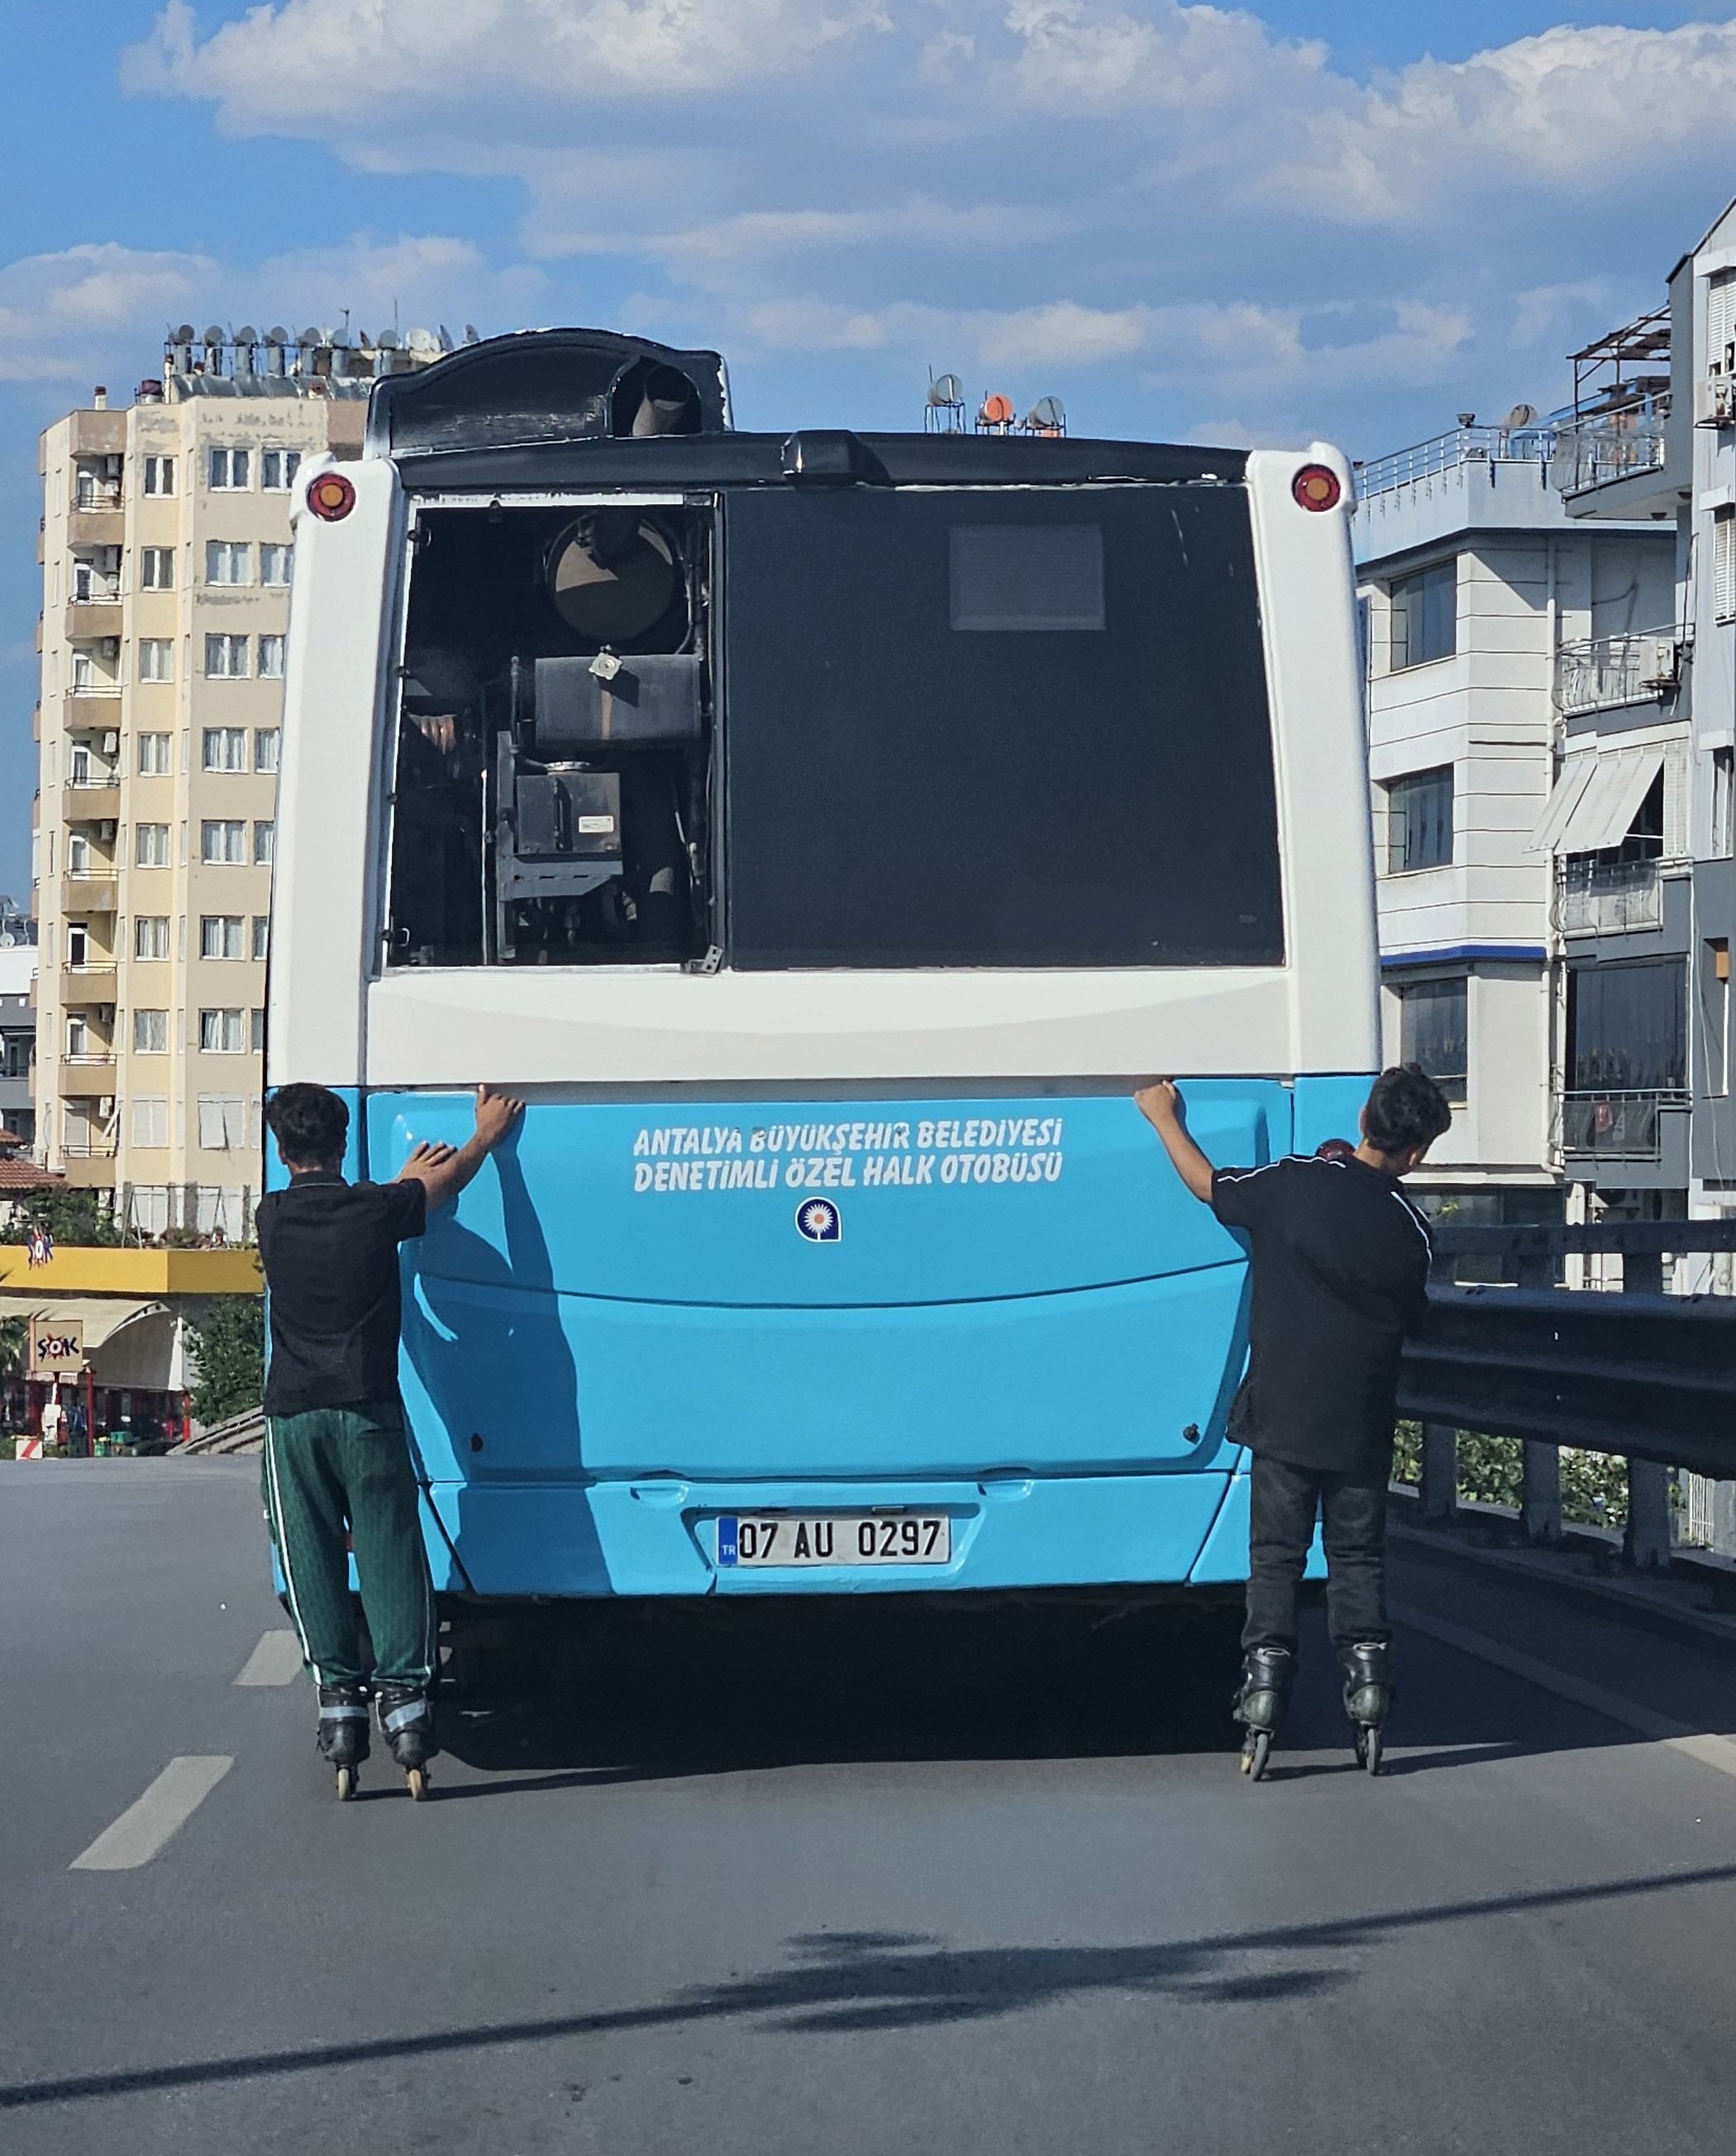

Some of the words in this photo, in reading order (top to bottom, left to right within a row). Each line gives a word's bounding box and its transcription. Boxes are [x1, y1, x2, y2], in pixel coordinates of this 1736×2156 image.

[633, 1126, 742, 1157] ANTALYA
[750, 1123, 909, 1157] BÜYÜKŞEHİR
[917, 1118, 1063, 1149] BELEDİYESİ
[634, 1159, 777, 1192] DENETİMLİ
[785, 1157, 856, 1188] ÖZEL
[863, 1155, 936, 1185] HALK
[940, 1152, 1063, 1184] OTOBÜSÜ
[722, 1545, 737, 1556] TR
[739, 1522, 779, 1559] 07
[794, 1522, 833, 1558] AU
[857, 1519, 942, 1557] 0297
